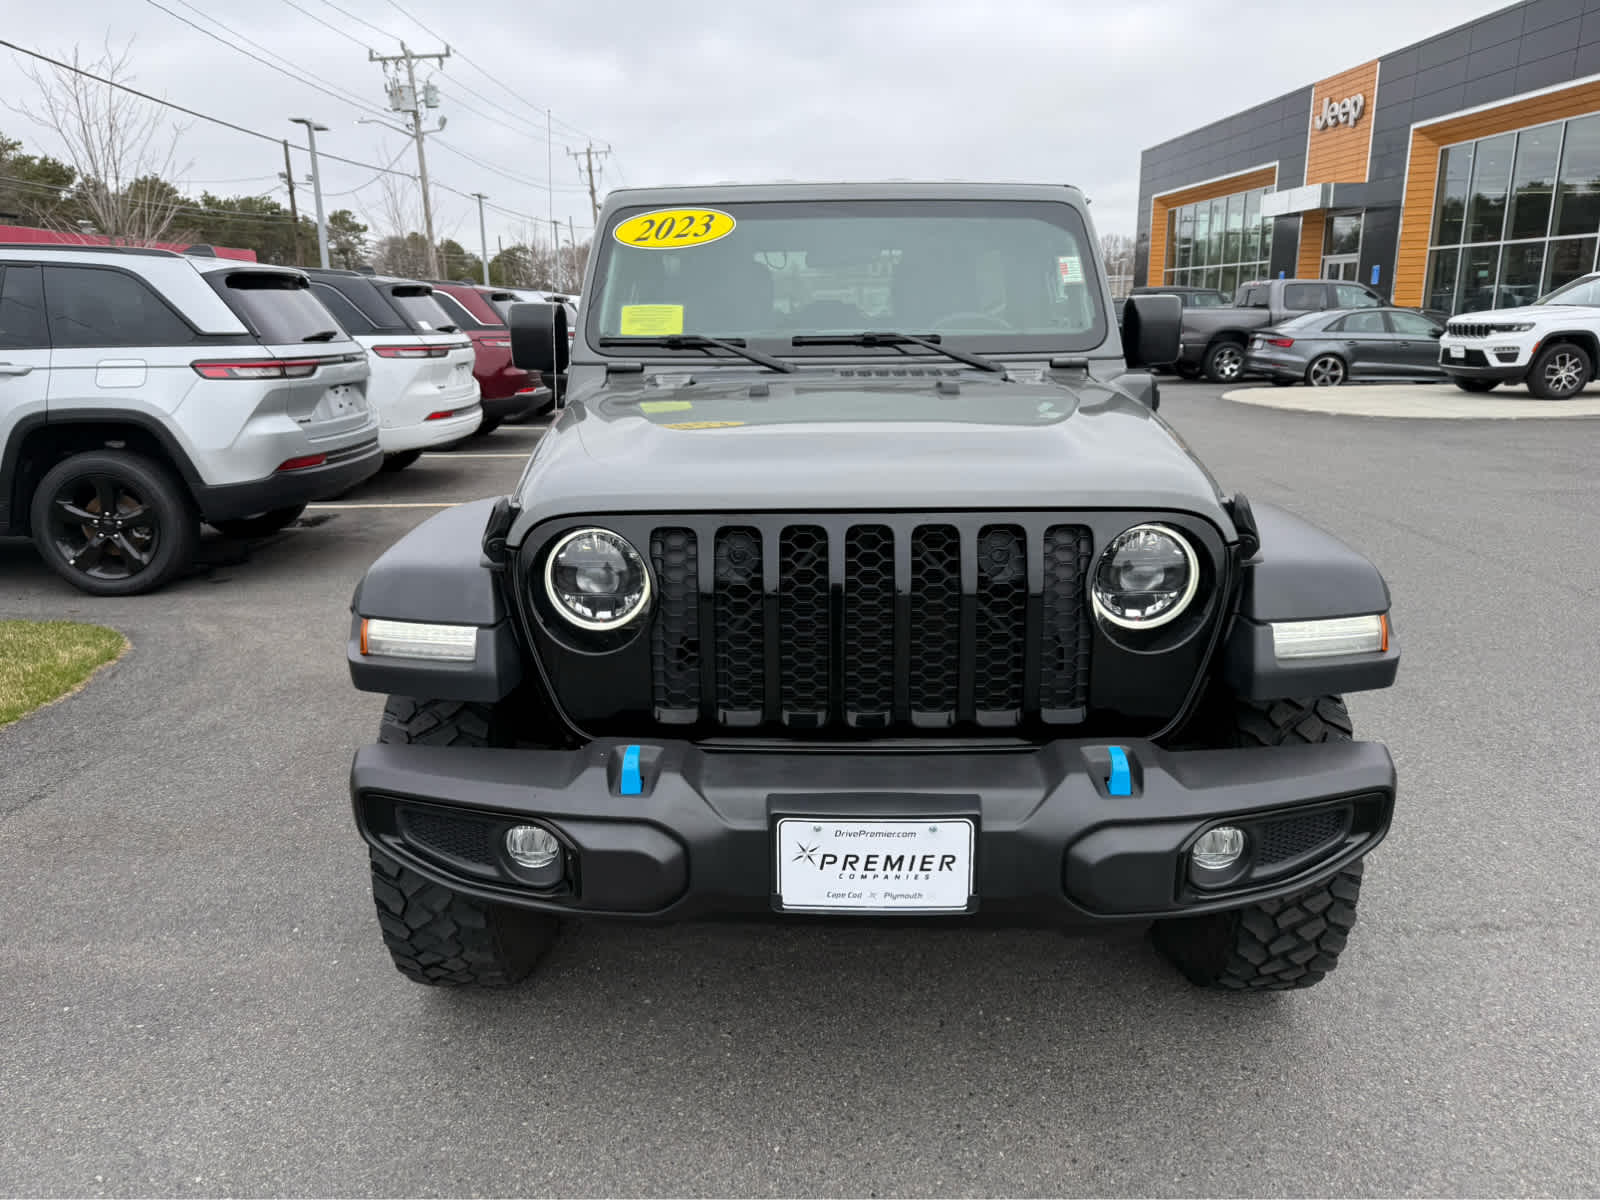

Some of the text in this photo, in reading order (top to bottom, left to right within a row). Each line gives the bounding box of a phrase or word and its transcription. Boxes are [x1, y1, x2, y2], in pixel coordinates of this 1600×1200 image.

[1315, 93, 1365, 130] Jeep
[633, 214, 716, 242] 2023
[834, 829, 917, 838] DrivePremier.com
[819, 853, 956, 872] PREMIER
[826, 891, 923, 900] Cape Cod Plymouth
